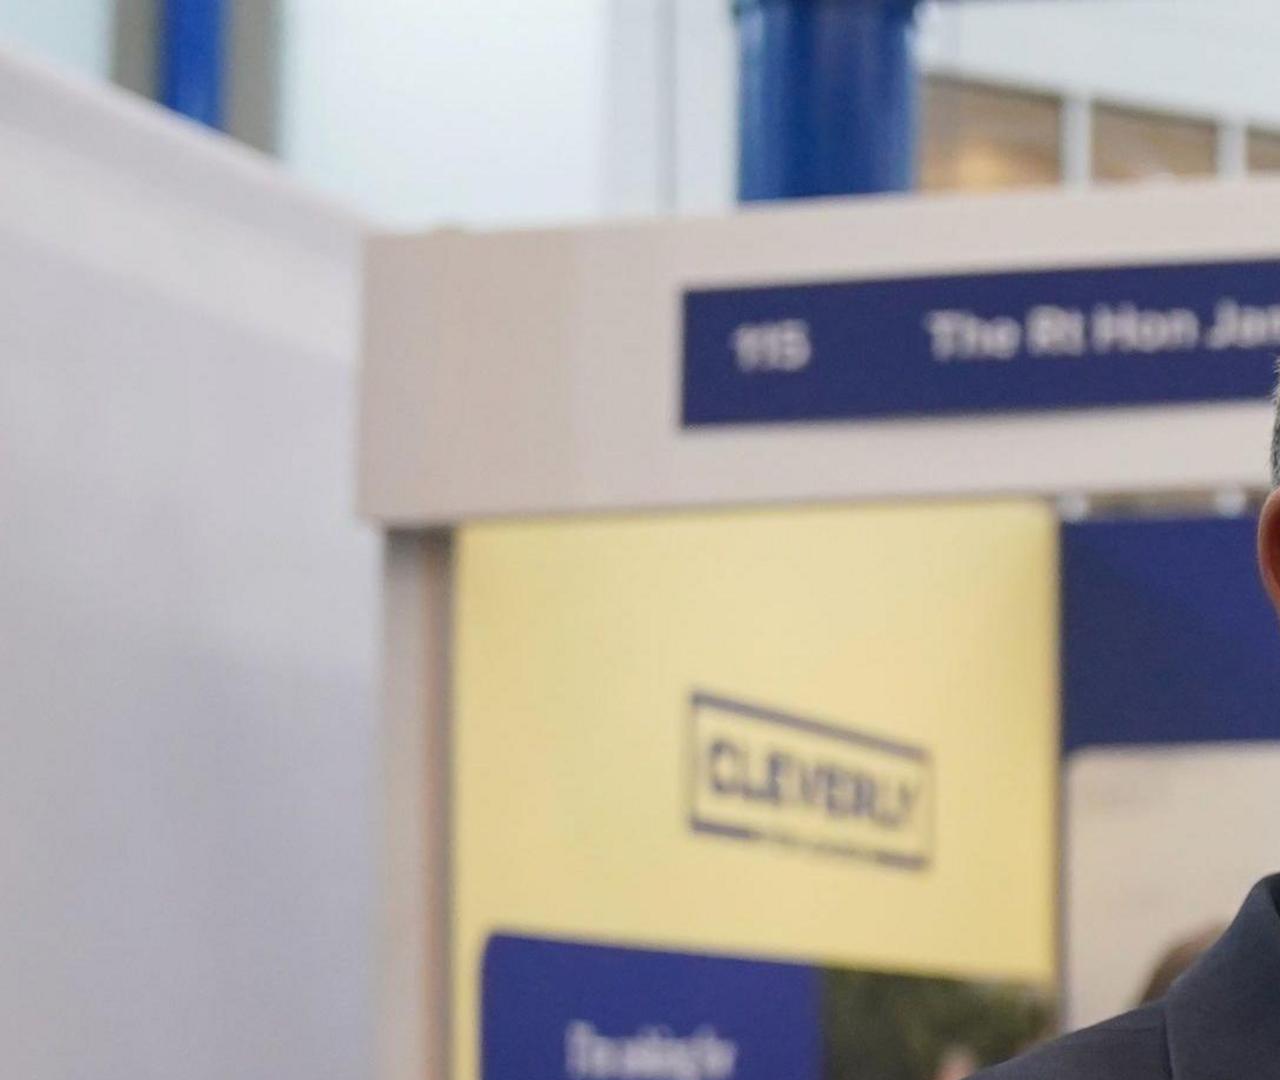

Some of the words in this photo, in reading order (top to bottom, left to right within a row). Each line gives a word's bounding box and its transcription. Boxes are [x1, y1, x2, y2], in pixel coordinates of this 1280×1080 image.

[925, 308, 1020, 363] The
[1027, 304, 1085, 357] Rt
[1092, 300, 1198, 353] Hon
[709, 738, 921, 829] CLEVERLY
